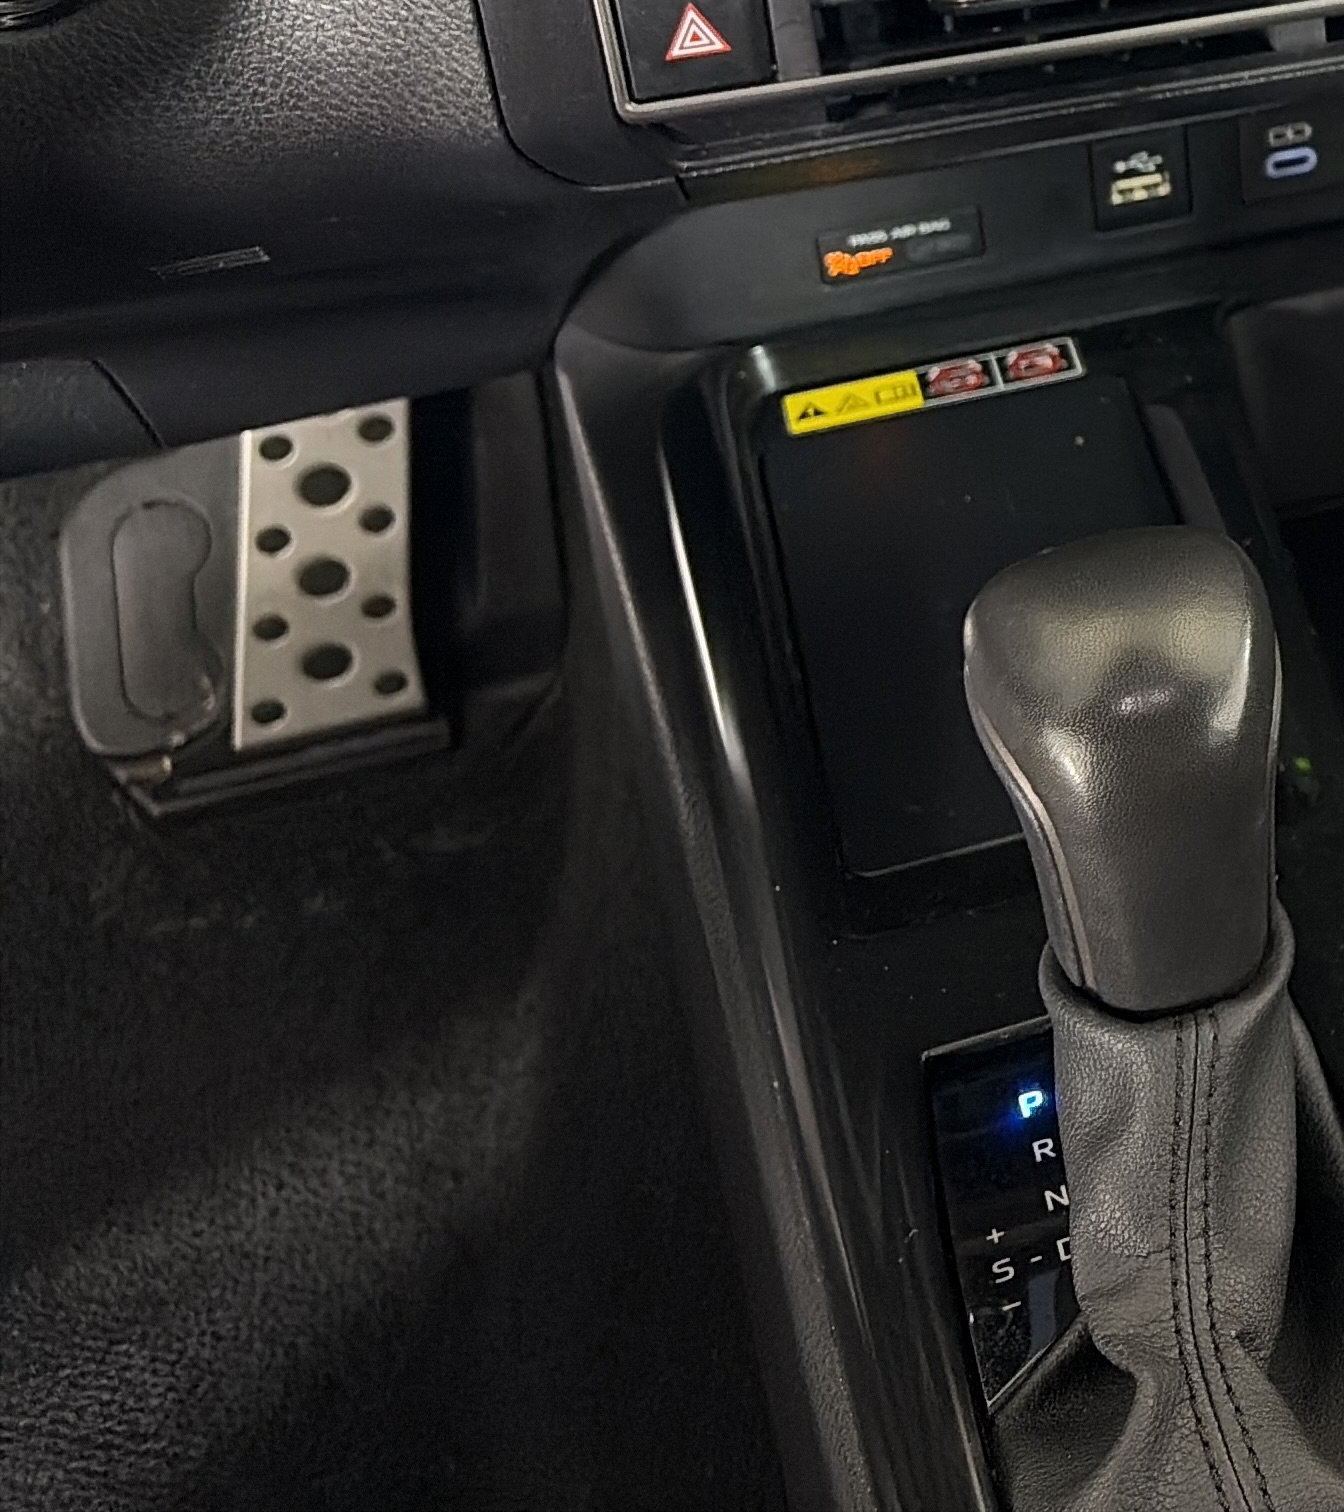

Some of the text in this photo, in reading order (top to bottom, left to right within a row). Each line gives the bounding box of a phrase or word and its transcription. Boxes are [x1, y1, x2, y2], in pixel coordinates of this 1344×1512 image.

[1017, 1089, 1045, 1118] P
[1032, 1138, 1057, 1163] R
[1044, 1184, 1070, 1211] N
[992, 1257, 1015, 1284] S
